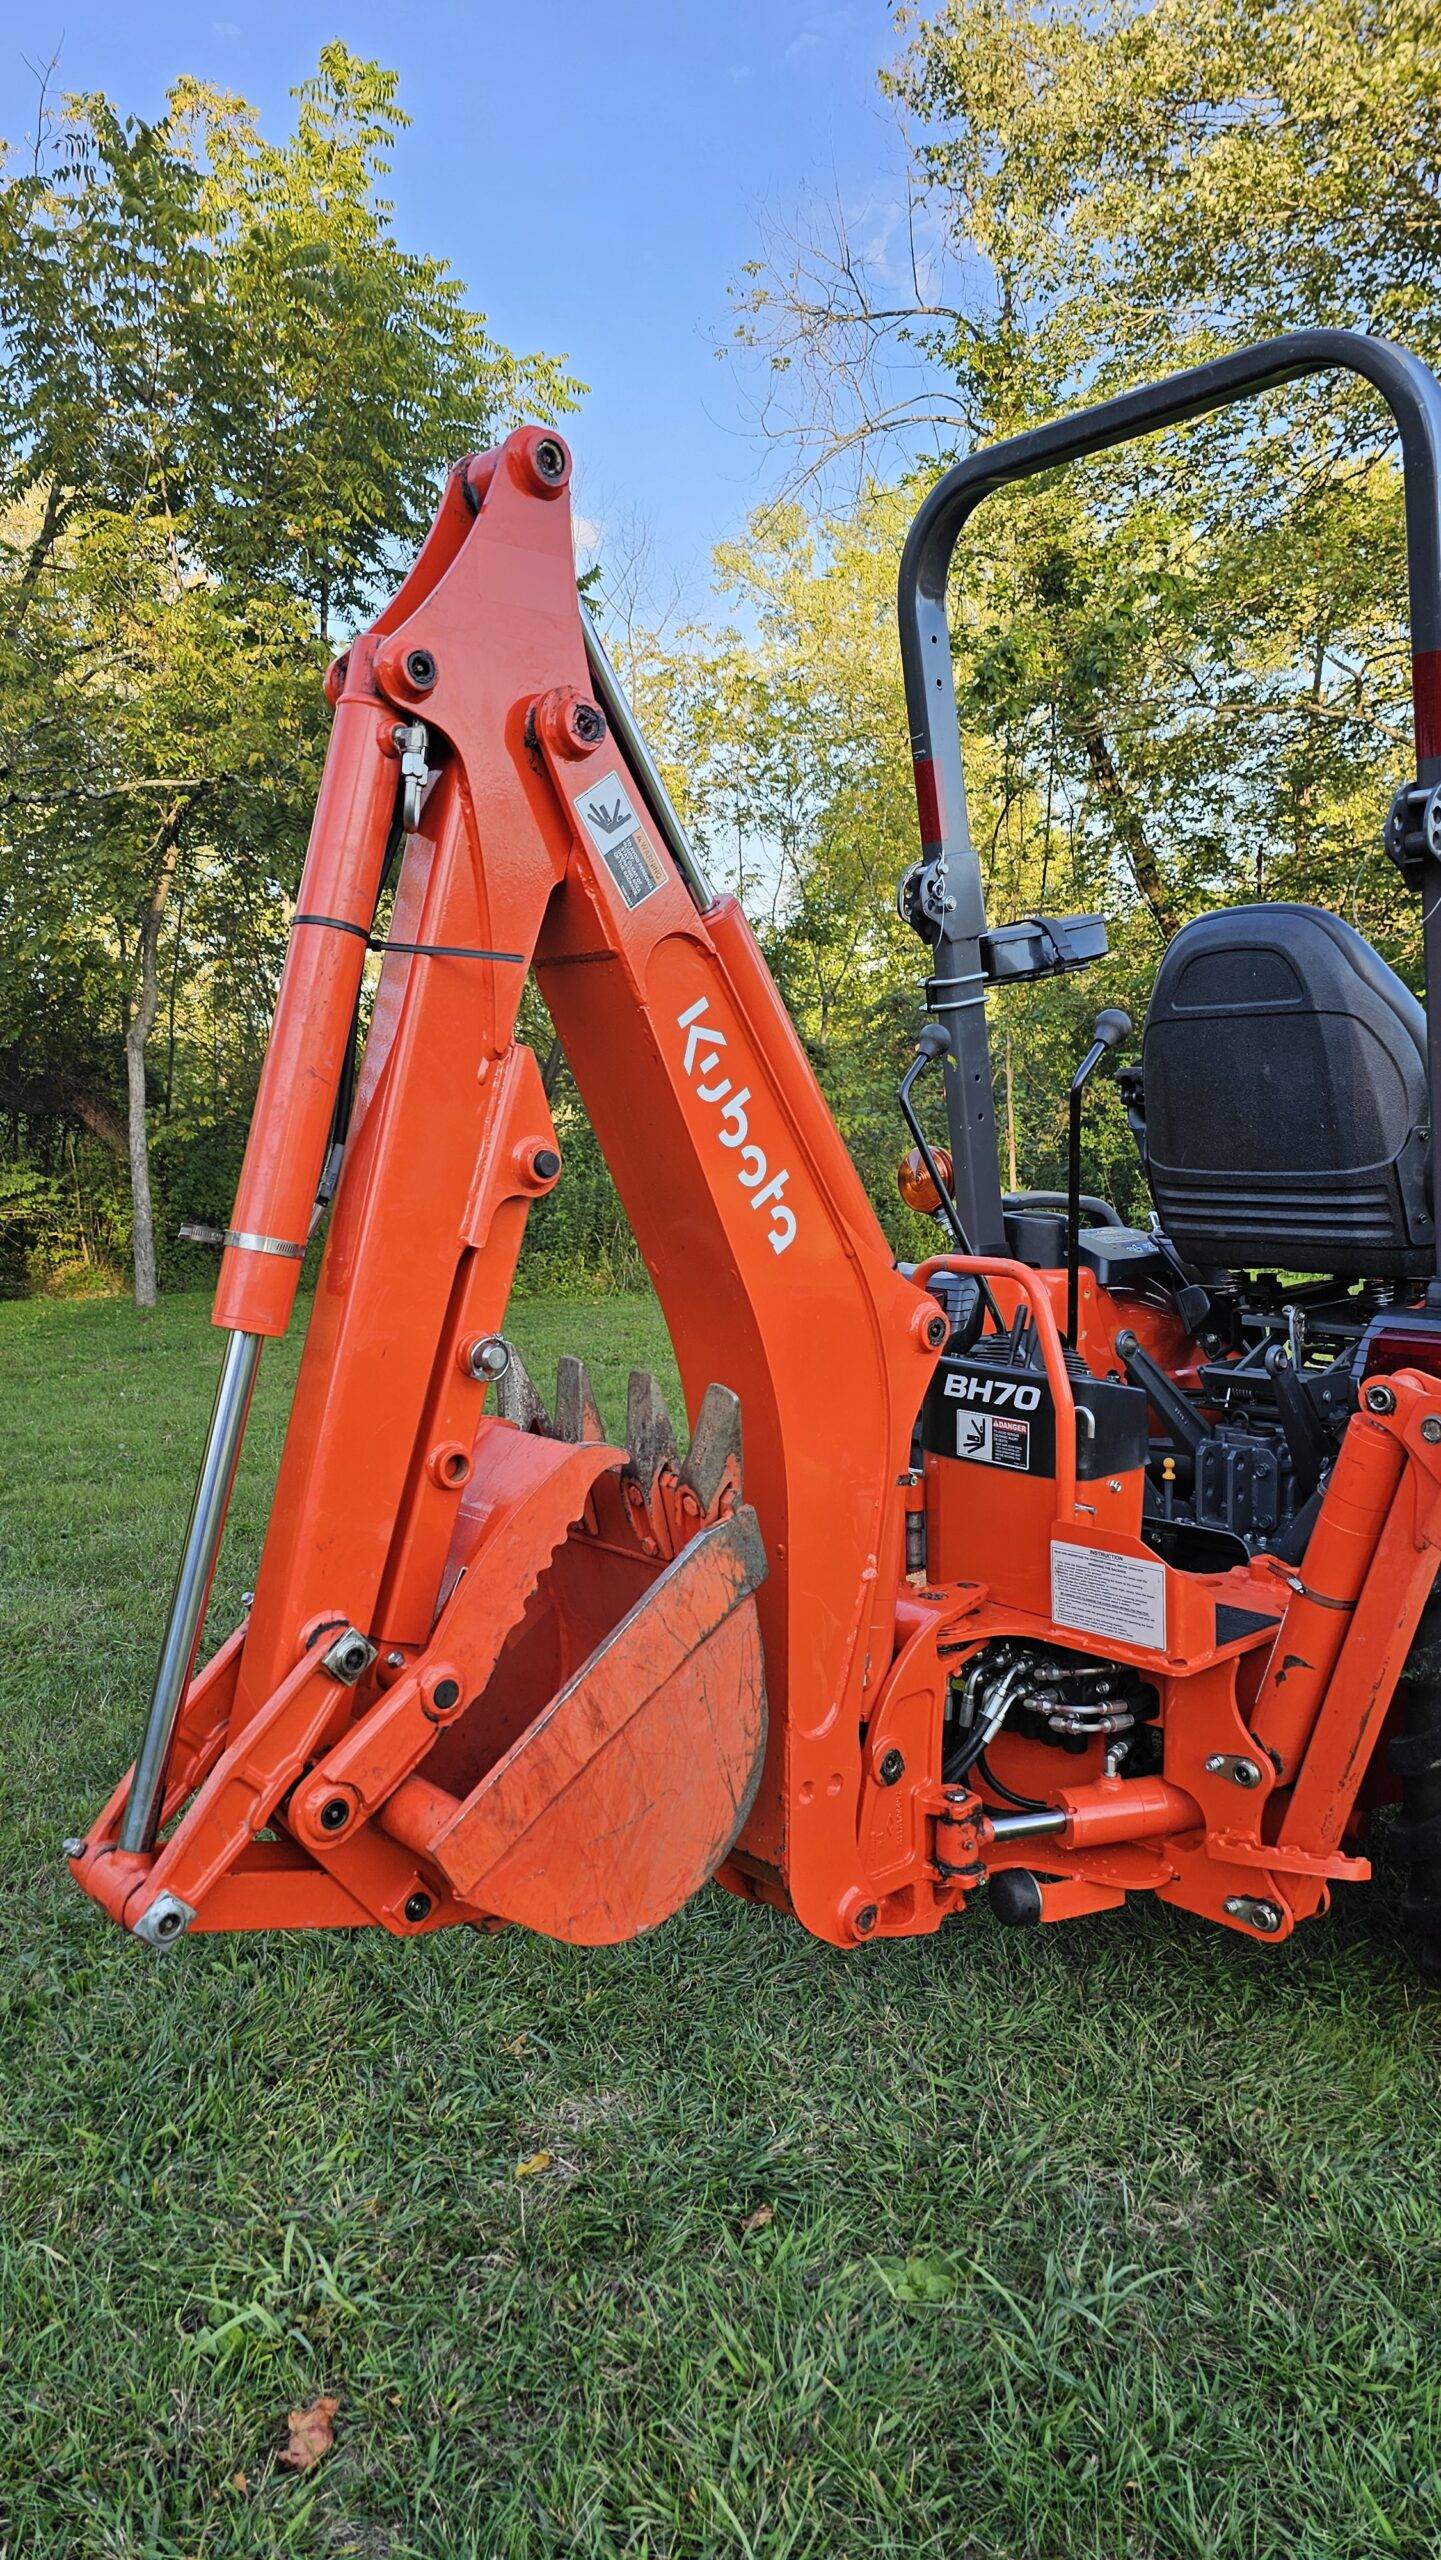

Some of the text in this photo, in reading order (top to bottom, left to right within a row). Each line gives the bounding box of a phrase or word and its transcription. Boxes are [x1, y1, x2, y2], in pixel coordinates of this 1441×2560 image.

[640, 840, 662, 879] WARNING
[677, 996, 797, 1256] Kubota
[943, 1373, 1041, 1411] BH70
[999, 1421, 1027, 1433] DANGER
[1089, 1549, 1123, 1561] INSTRUCTION
